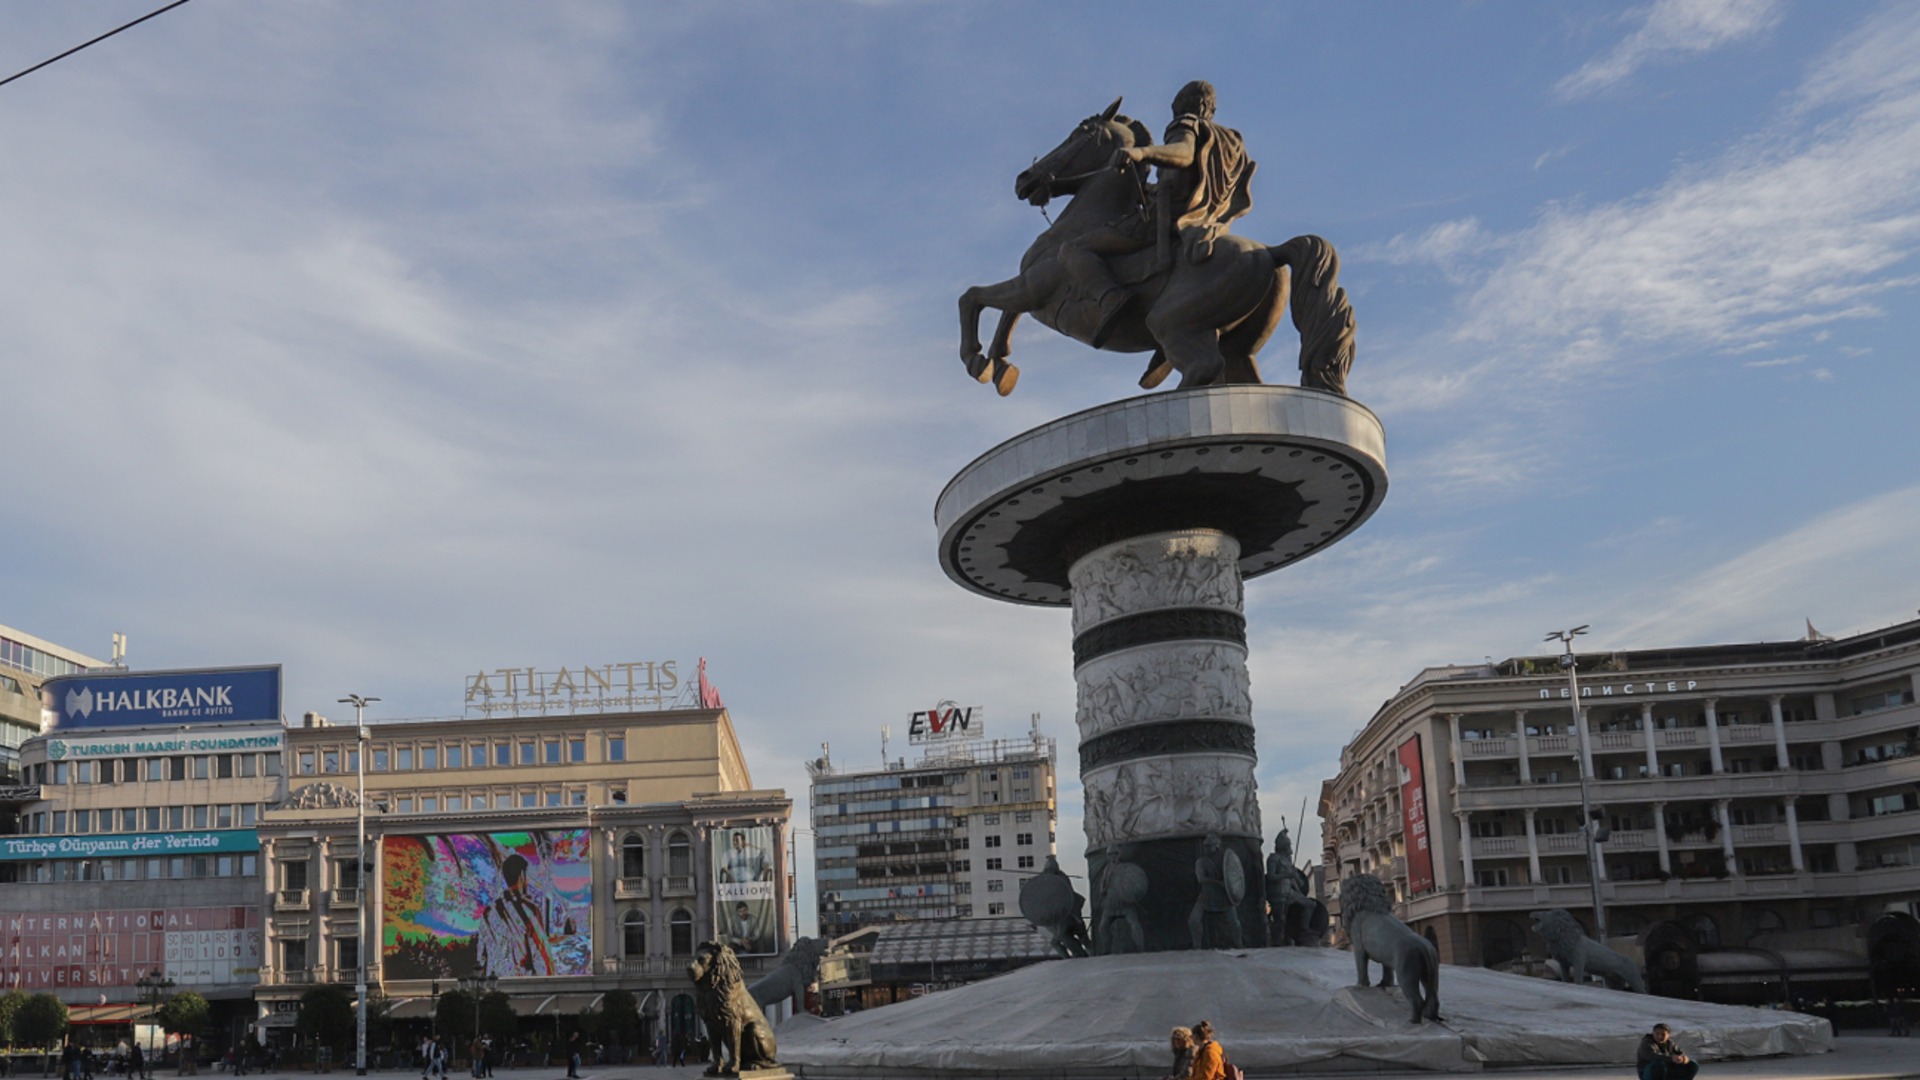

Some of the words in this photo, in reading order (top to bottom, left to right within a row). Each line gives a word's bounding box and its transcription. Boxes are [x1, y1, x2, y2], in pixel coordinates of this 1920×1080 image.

[467, 660, 678, 701] ATLANTIS
[1540, 681, 1697, 699] ПЕЛИСТЕР
[96, 685, 232, 712] HALKBANK
[909, 707, 972, 735] EVN
[72, 743, 130, 755] TURKISH
[135, 740, 185, 753] MAARIF
[190, 736, 279, 750] FOUNDATION
[5, 840, 57, 857] Türkçe
[59, 838, 129, 855] Dünyanın
[131, 836, 162, 851] Her
[164, 834, 220, 849] Yerinde
